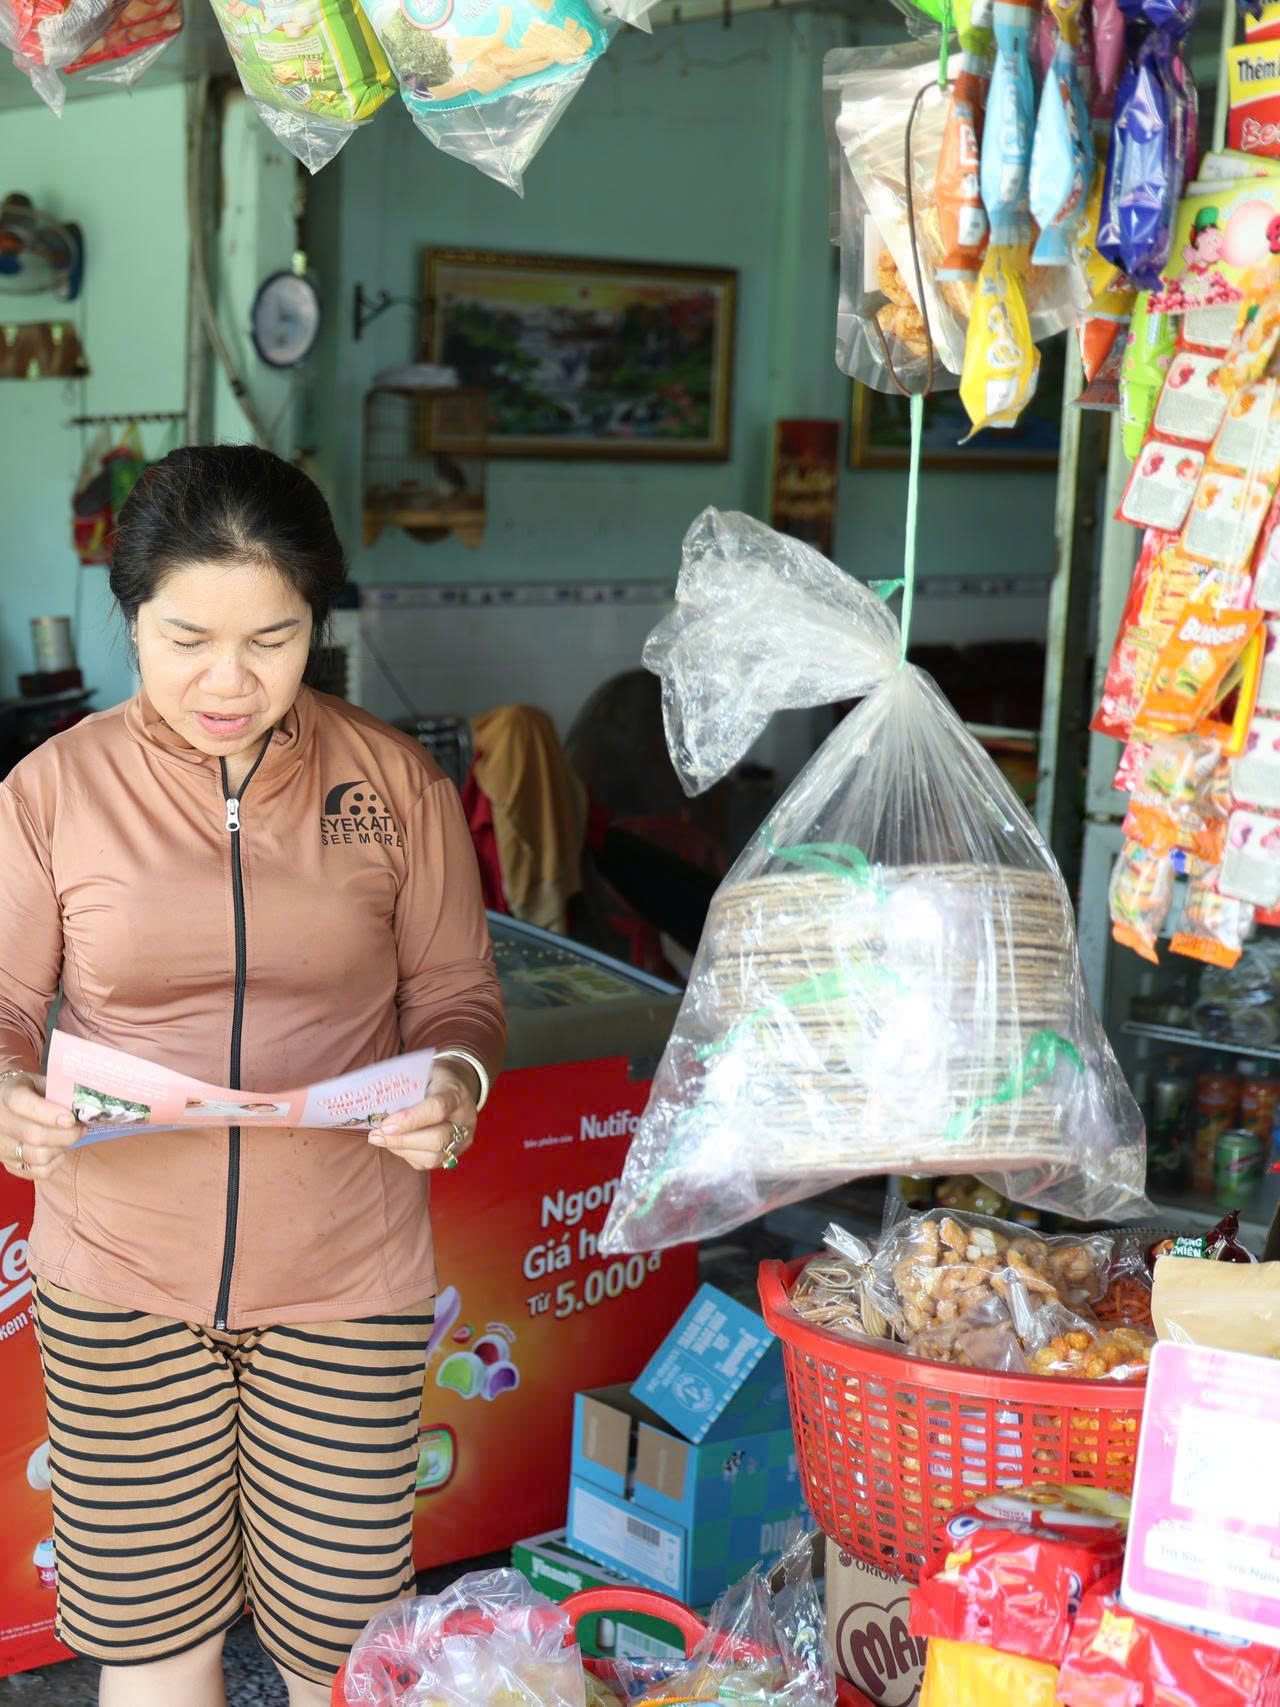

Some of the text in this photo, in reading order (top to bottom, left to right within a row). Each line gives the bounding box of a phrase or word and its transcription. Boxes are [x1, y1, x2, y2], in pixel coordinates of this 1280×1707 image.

[322, 832, 404, 848] SEE MORE
[580, 1109, 641, 1141] Nutifo
[523, 1232, 571, 1280] Giá
[527, 1292, 551, 1316] Từ
[850, 1615, 928, 1697] MA
